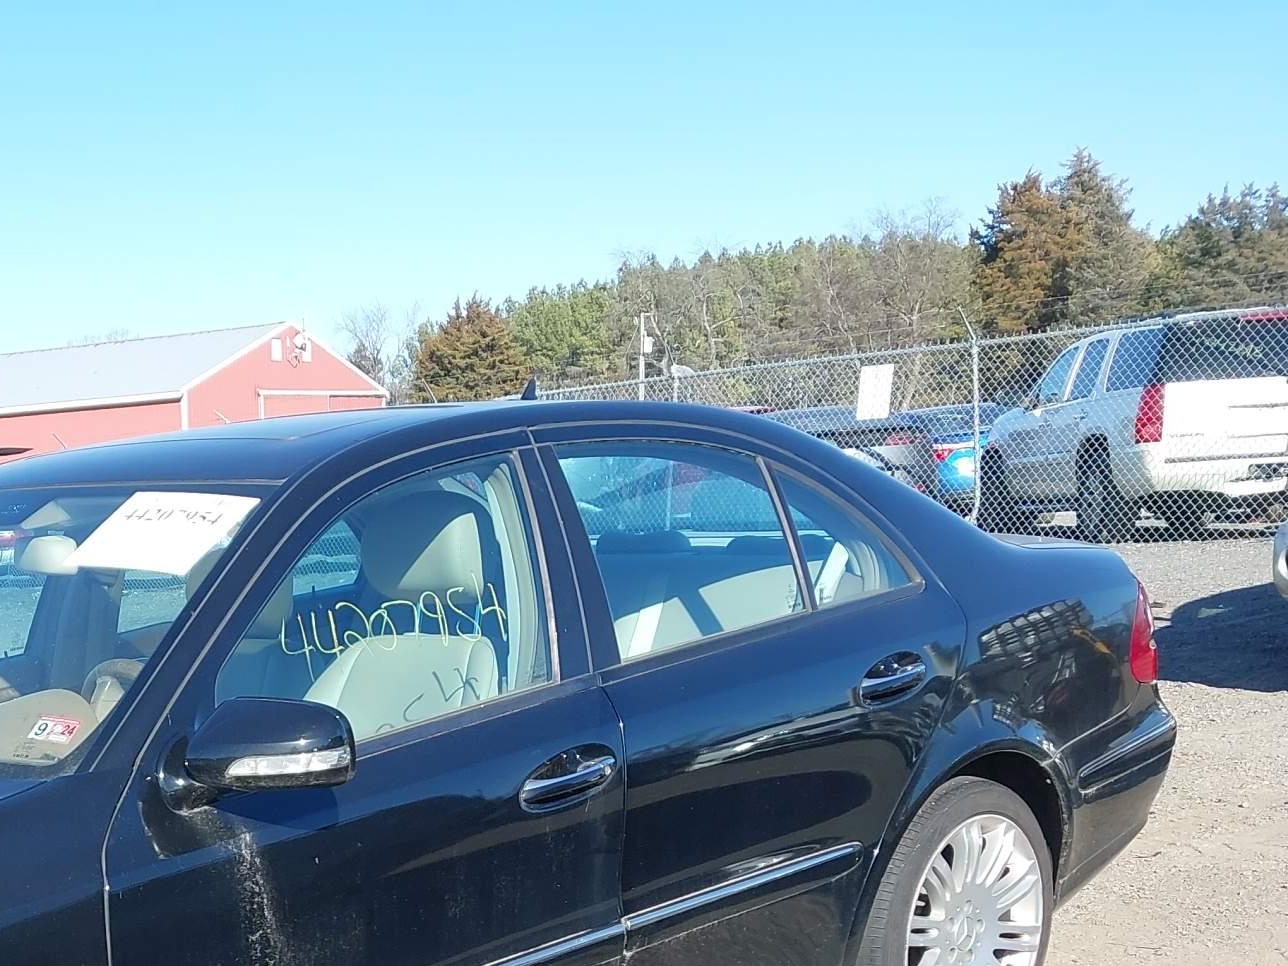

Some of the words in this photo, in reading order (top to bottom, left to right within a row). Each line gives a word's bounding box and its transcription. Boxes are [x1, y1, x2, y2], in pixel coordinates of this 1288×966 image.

[278, 573, 508, 683] 44207954
[34, 722, 49, 736] 9
[60, 724, 77, 737] 24
